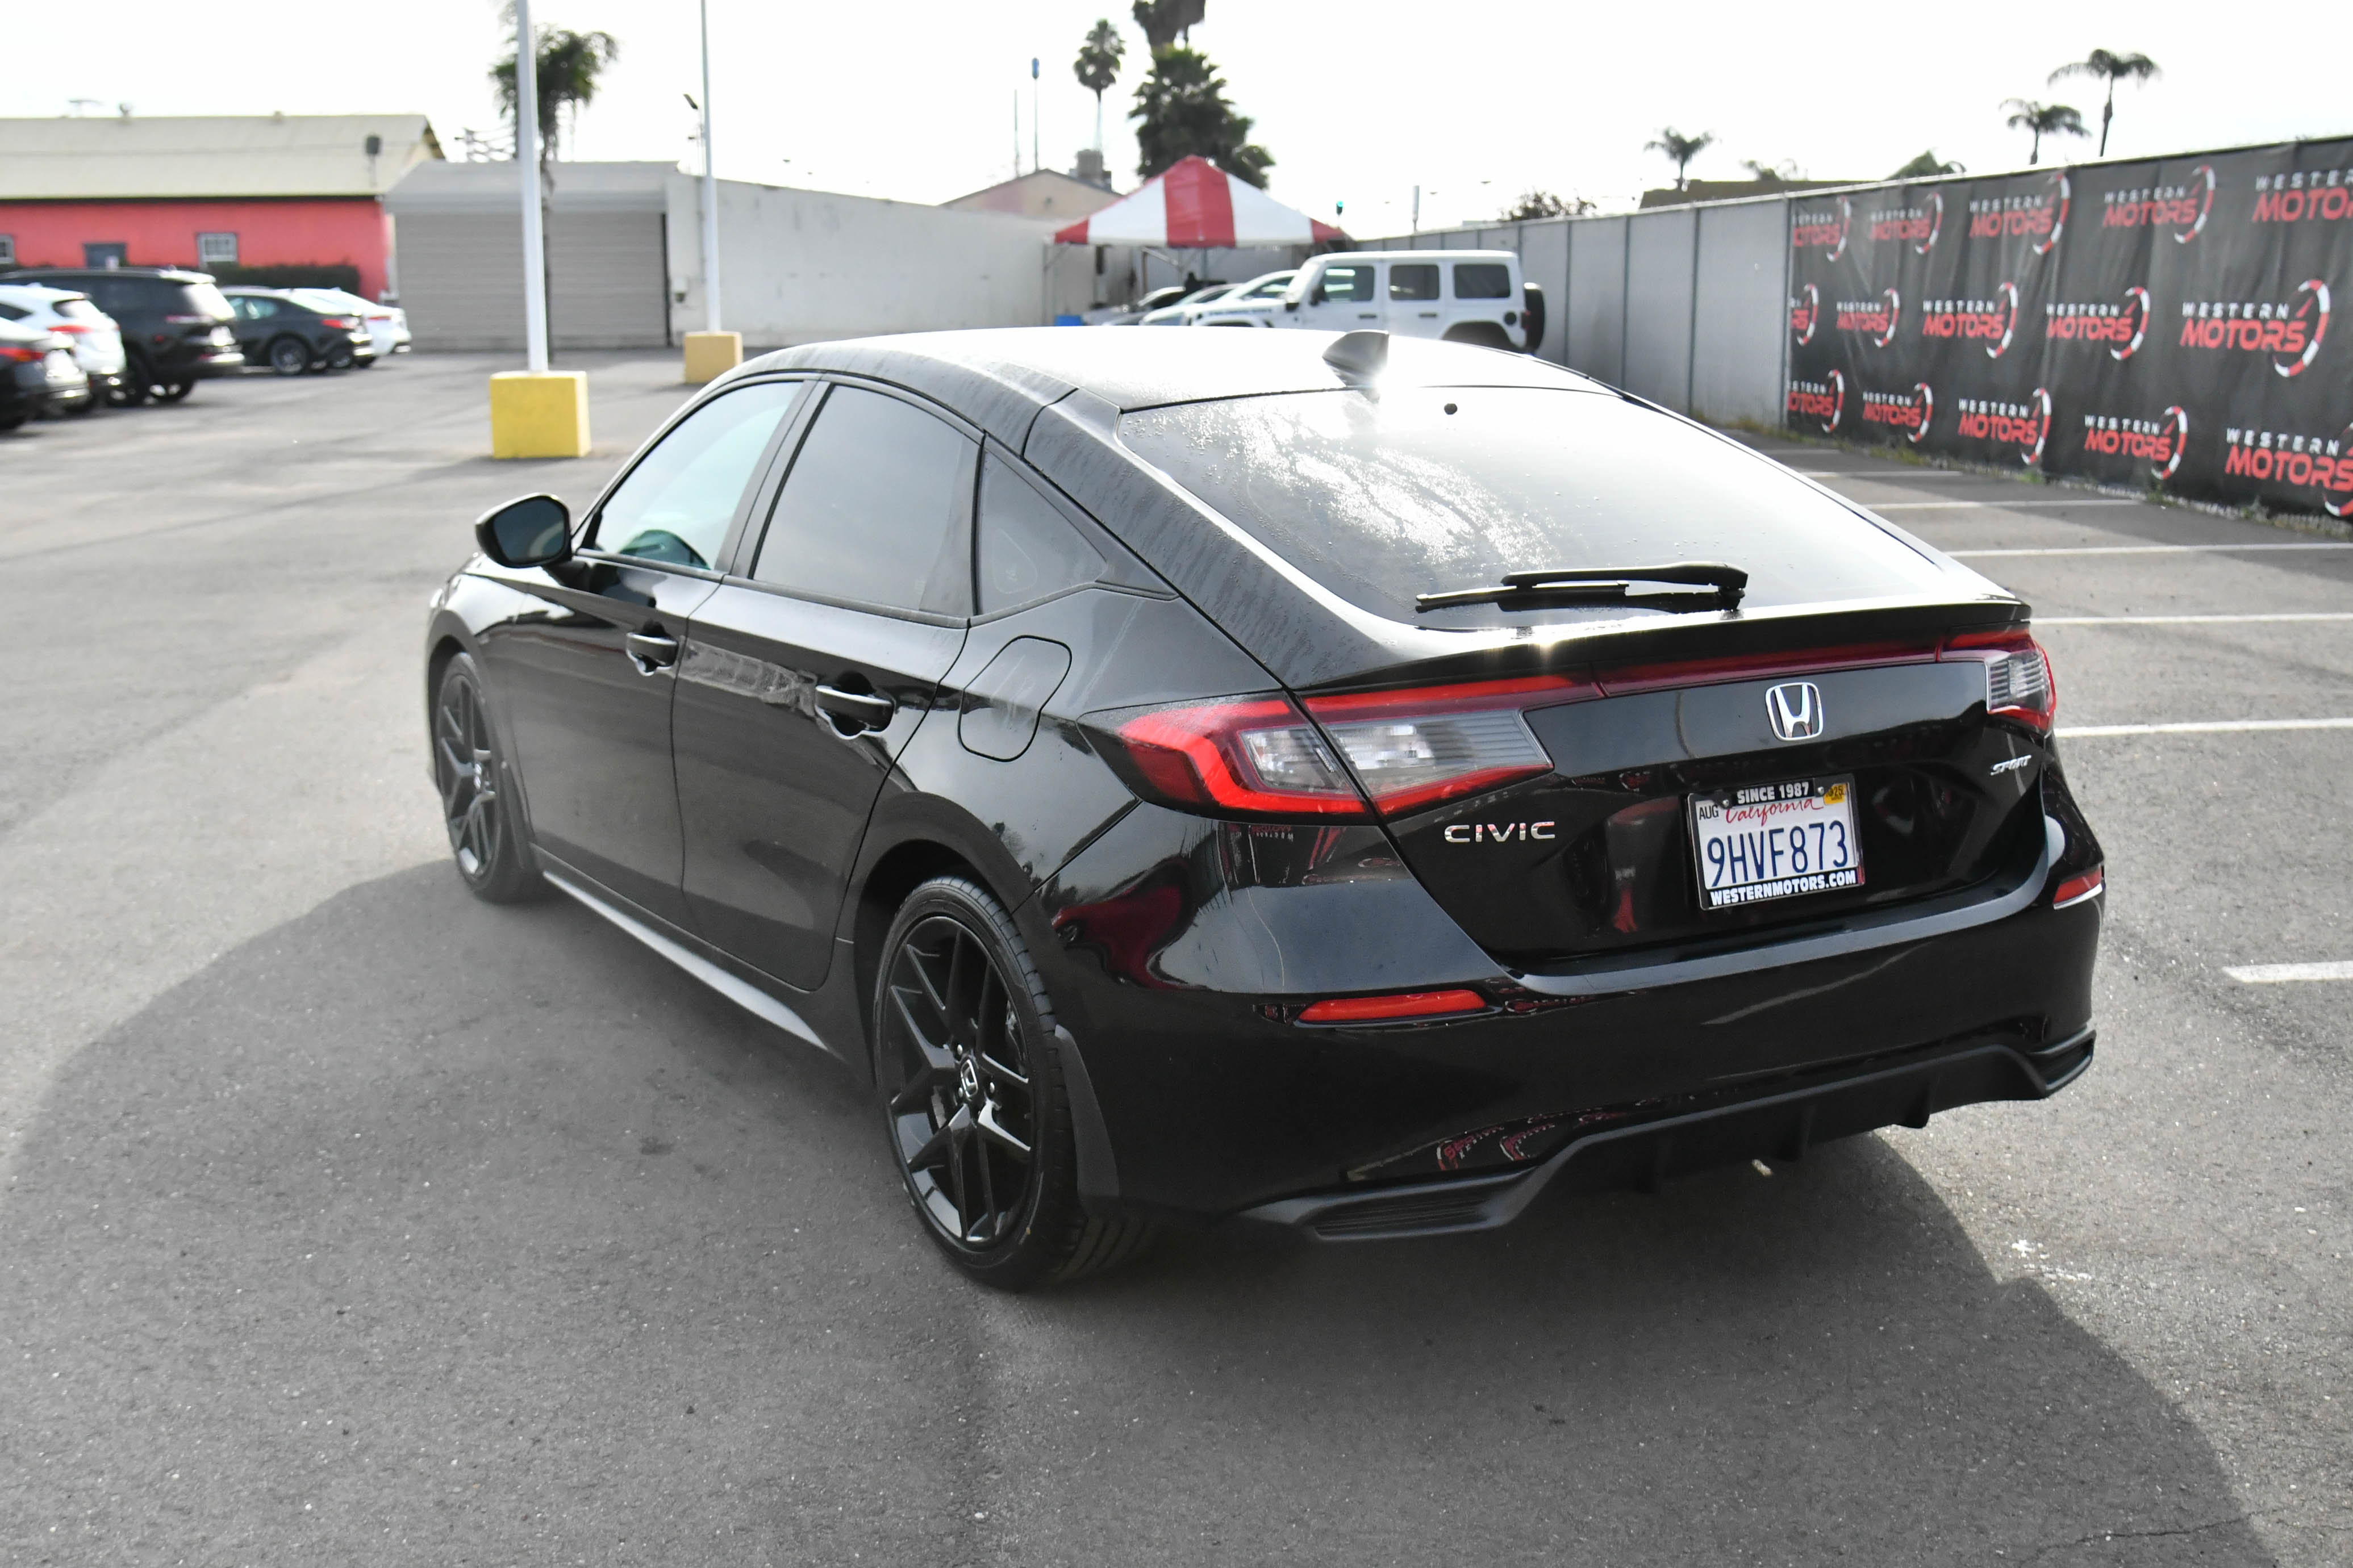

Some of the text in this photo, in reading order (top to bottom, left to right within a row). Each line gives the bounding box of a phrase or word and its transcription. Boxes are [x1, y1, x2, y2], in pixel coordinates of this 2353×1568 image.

[2255, 169, 2353, 191] WESTER
[1969, 194, 2042, 212] WESTERN
[2104, 186, 2186, 202] WESTERN
[2252, 187, 2353, 223] MOTO
[1969, 207, 2054, 238] MOTORS
[2103, 198, 2198, 227] MOTORS
[1923, 300, 1995, 312] WESTERN
[2046, 303, 2120, 316] WESTERN
[2182, 302, 2290, 319] WESTERN
[1922, 312, 2006, 339] MOTORS
[2046, 316, 2133, 340] MOTORS
[2180, 318, 2306, 352] MOTORS
[1788, 391, 1835, 417] OTORS
[1862, 401, 1921, 427] MOTORS
[1958, 398, 2029, 418] WESTERN
[1958, 411, 2038, 445] MOTORS
[2084, 415, 2160, 435] WESTERN
[2084, 428, 2172, 462] MOTORS
[2226, 428, 2340, 457] WESTERN
[2224, 444, 2353, 492] MOTORS
[1990, 755, 2032, 776] SPORT
[1737, 781, 1809, 805] SINCE 1987
[1699, 805, 1720, 820] AUG
[1445, 821, 1556, 843] CIVIC
[1707, 820, 1848, 887] 9HVF873
[1710, 869, 1856, 906] WESTERNMOTORS.COM
